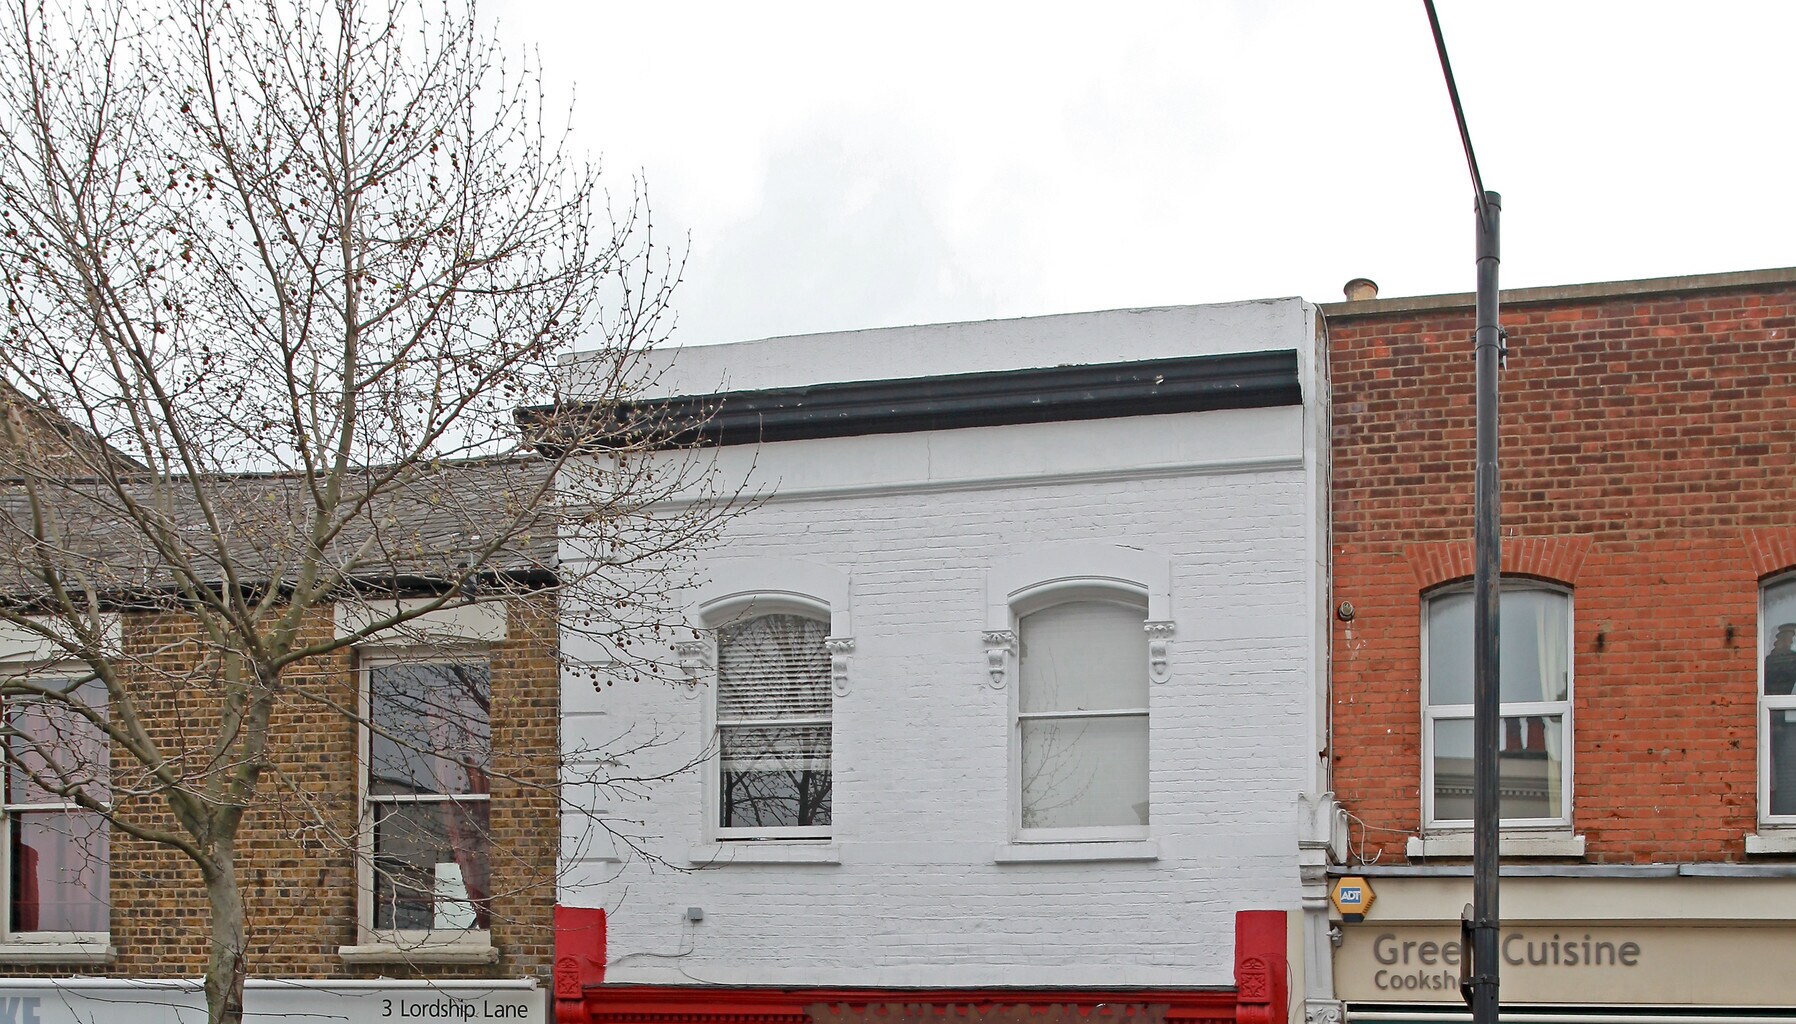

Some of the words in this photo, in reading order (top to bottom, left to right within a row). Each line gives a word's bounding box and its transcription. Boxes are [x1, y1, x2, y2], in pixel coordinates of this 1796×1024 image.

[1341, 891, 1361, 900] ADT
[1373, 933, 1462, 965] Gree
[1502, 933, 1641, 966] Cuisine
[1374, 969, 1462, 990] Cooksh
[382, 999, 392, 1017] 3
[401, 998, 475, 1022] Lordship
[484, 1000, 528, 1018] Lane
